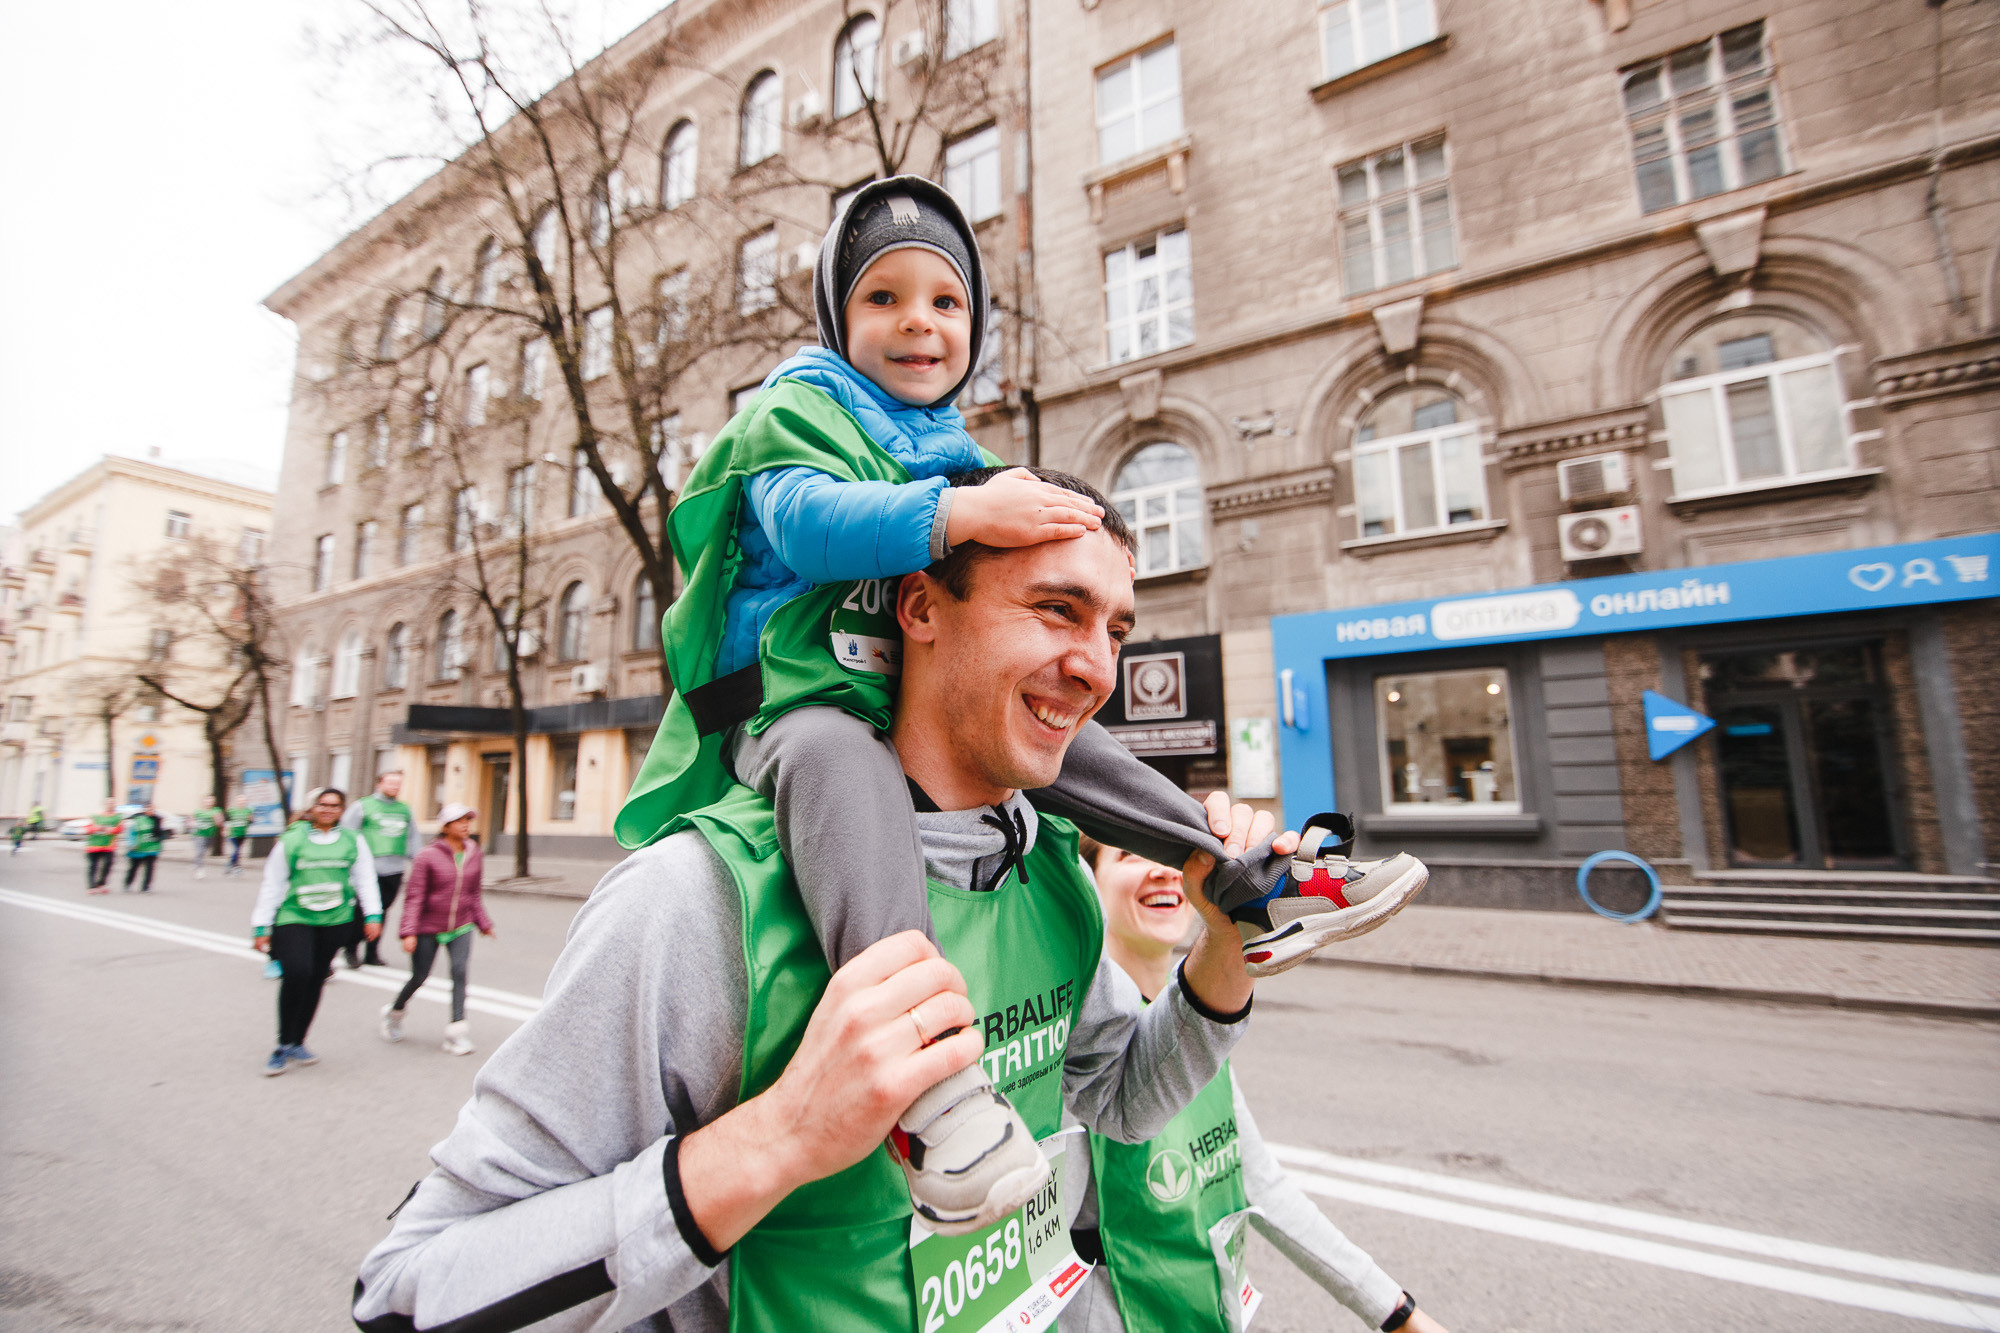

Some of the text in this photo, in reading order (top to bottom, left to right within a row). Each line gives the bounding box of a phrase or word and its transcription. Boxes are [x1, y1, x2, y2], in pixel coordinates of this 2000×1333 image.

[1336, 578, 1731, 643] новая оптика онлайн
[972, 978, 1073, 1048] RBALIFE
[1026, 1181, 1058, 1227] RUN
[1028, 1214, 1061, 1254] 1,6 KM
[922, 1218, 1022, 1333] 20658
